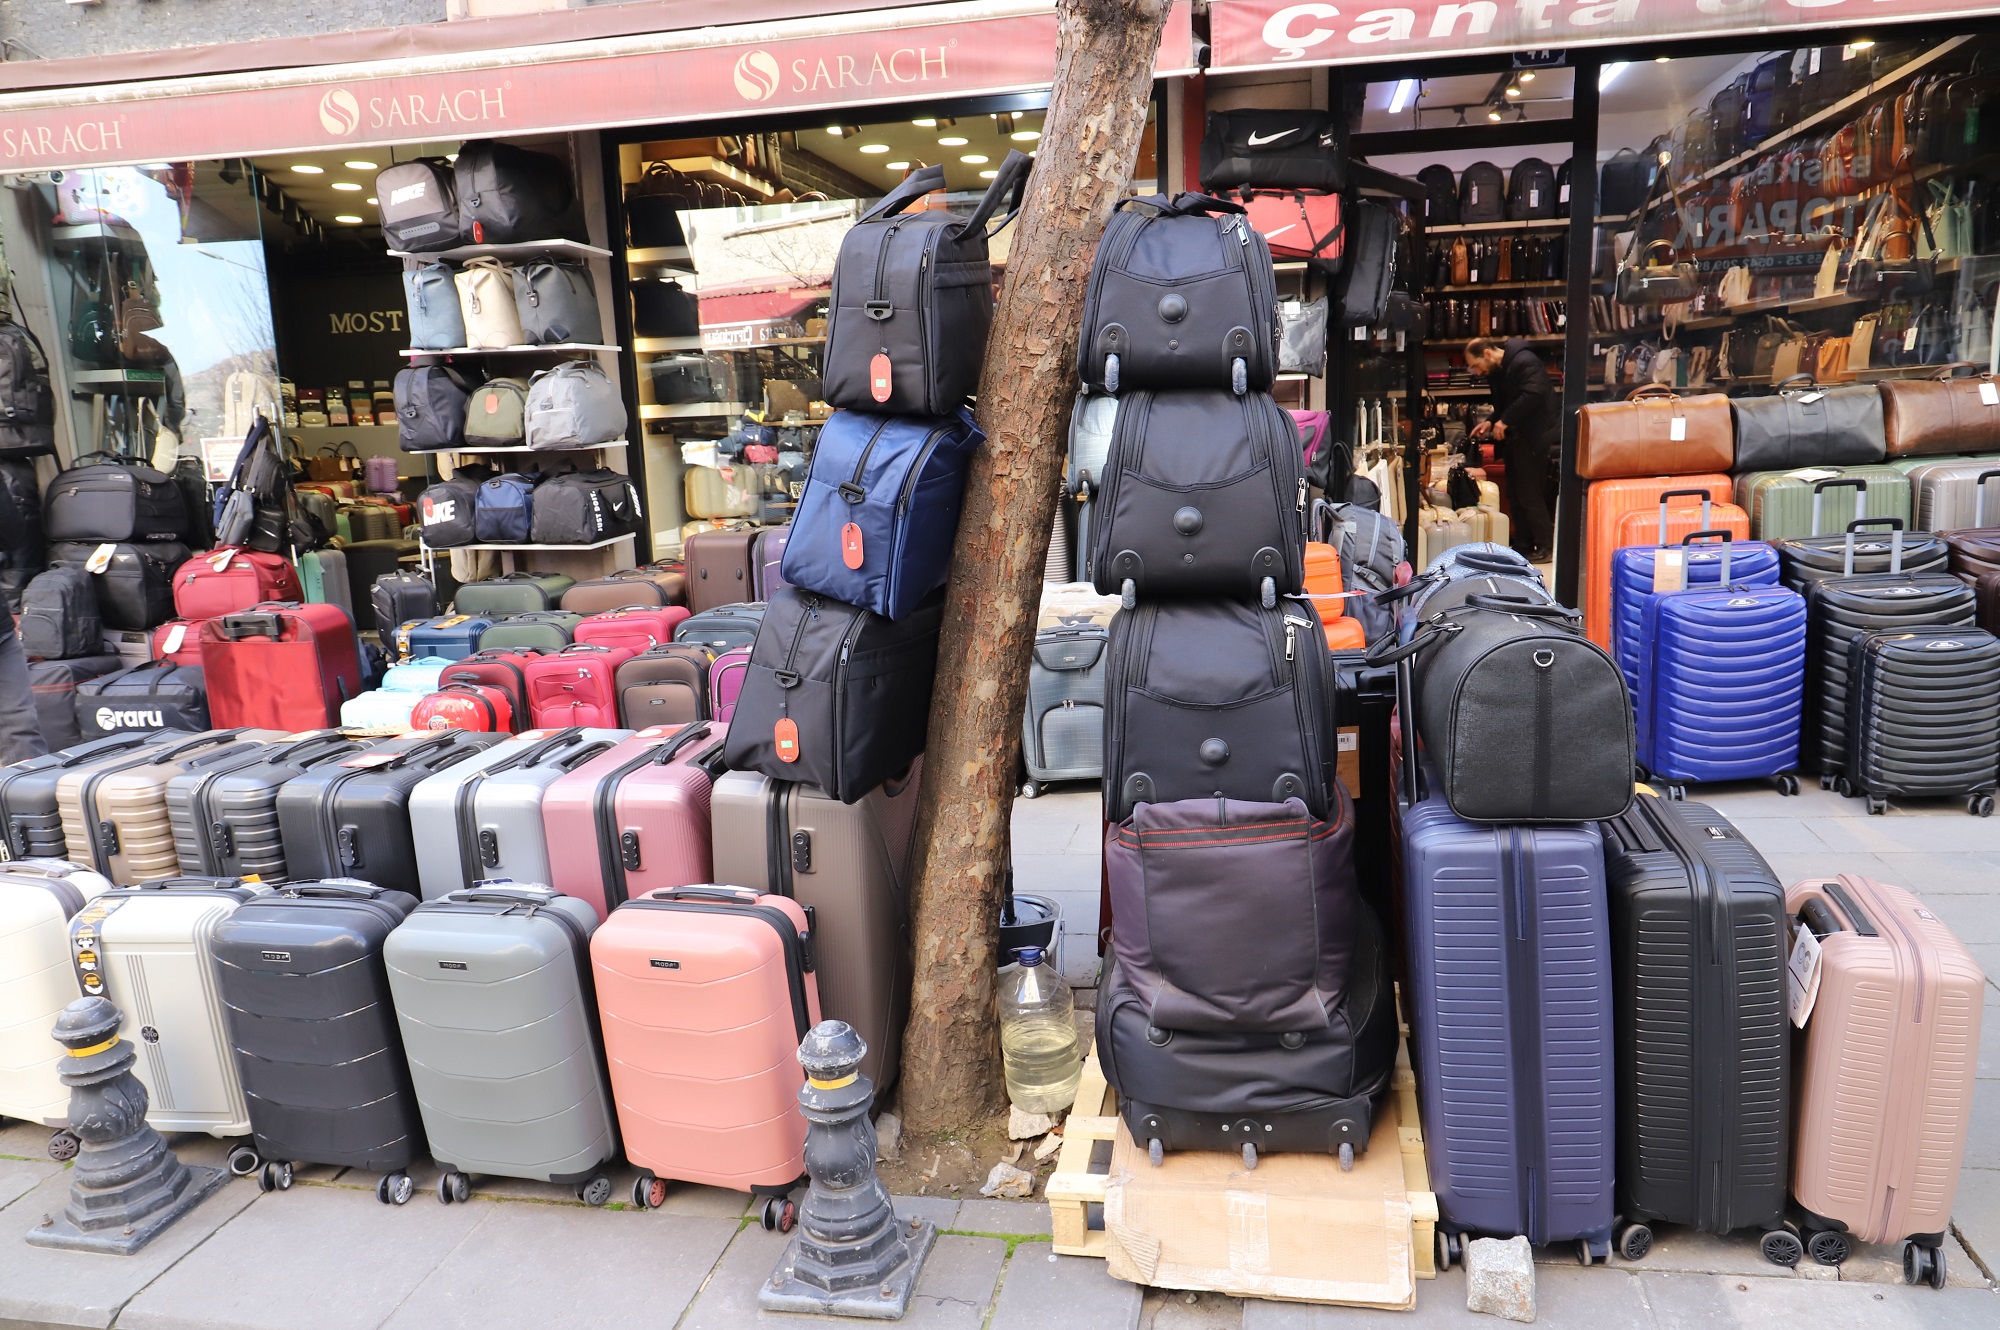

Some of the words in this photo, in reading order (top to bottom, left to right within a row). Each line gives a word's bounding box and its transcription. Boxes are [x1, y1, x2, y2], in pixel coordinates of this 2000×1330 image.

[791, 45, 950, 93] SARACH
[369, 87, 507, 129] SARACH
[3, 120, 124, 158] SARACH
[391, 182, 426, 206] NIKE
[329, 310, 404, 334] MOST
[115, 710, 165, 728] raru
